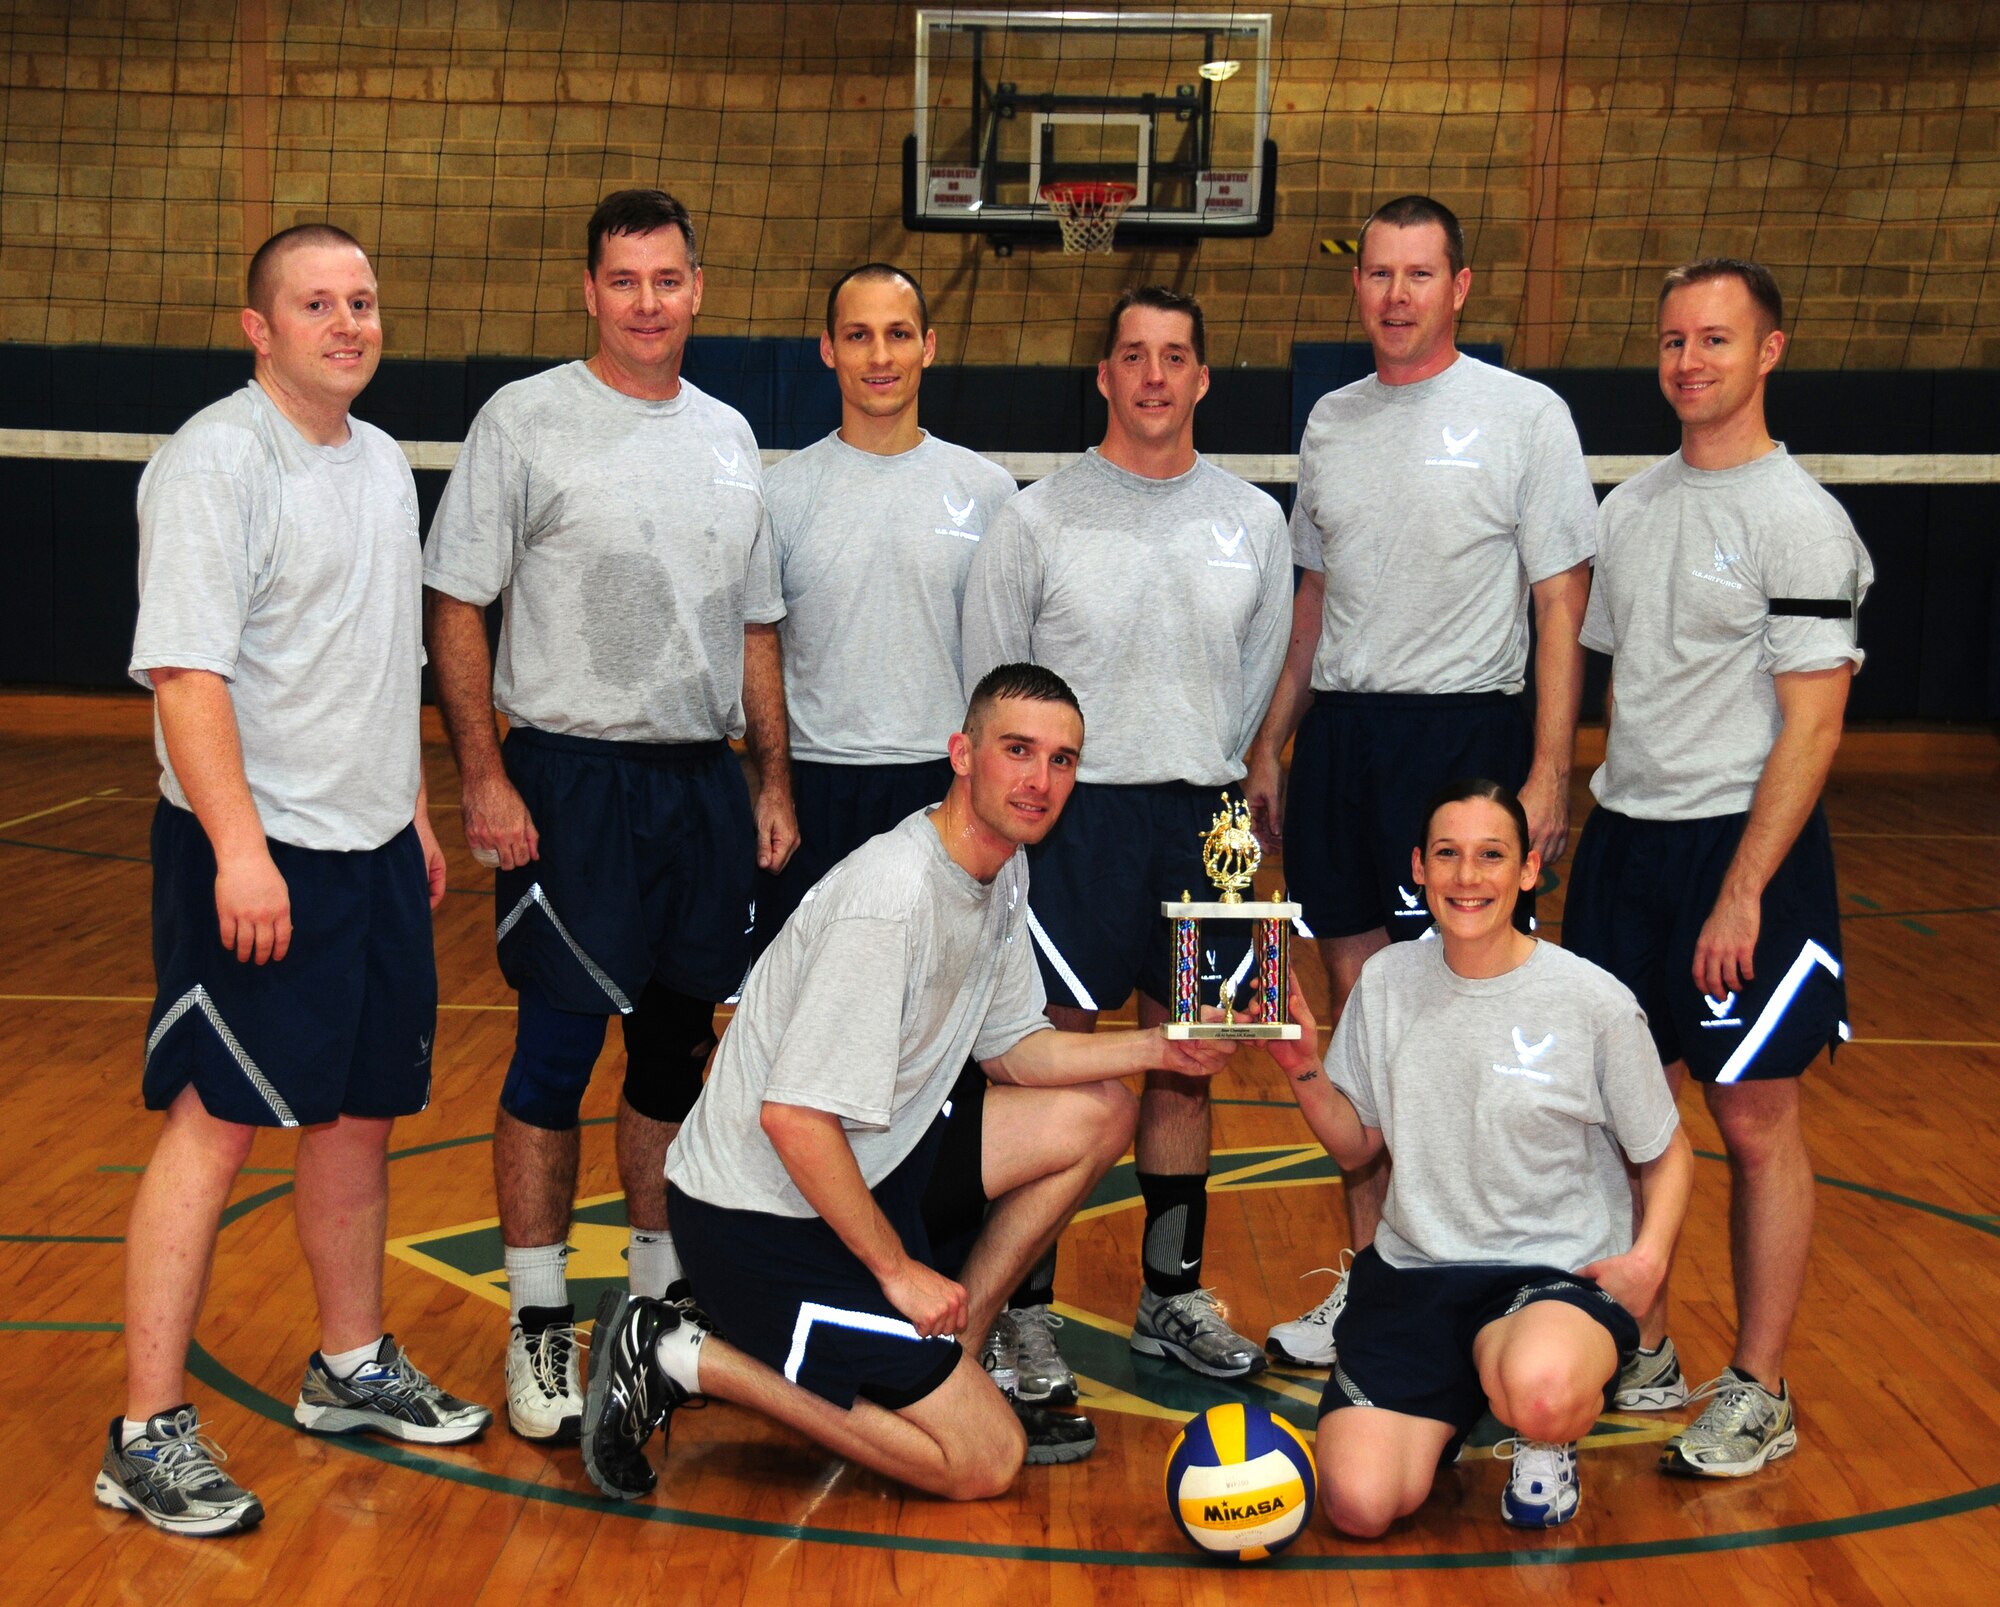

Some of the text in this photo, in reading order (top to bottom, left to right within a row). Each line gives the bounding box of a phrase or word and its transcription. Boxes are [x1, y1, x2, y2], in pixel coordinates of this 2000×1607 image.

[931, 169, 976, 178] ABSOLUTELY
[948, 182, 958, 190] NO
[1219, 186, 1229, 194] NO
